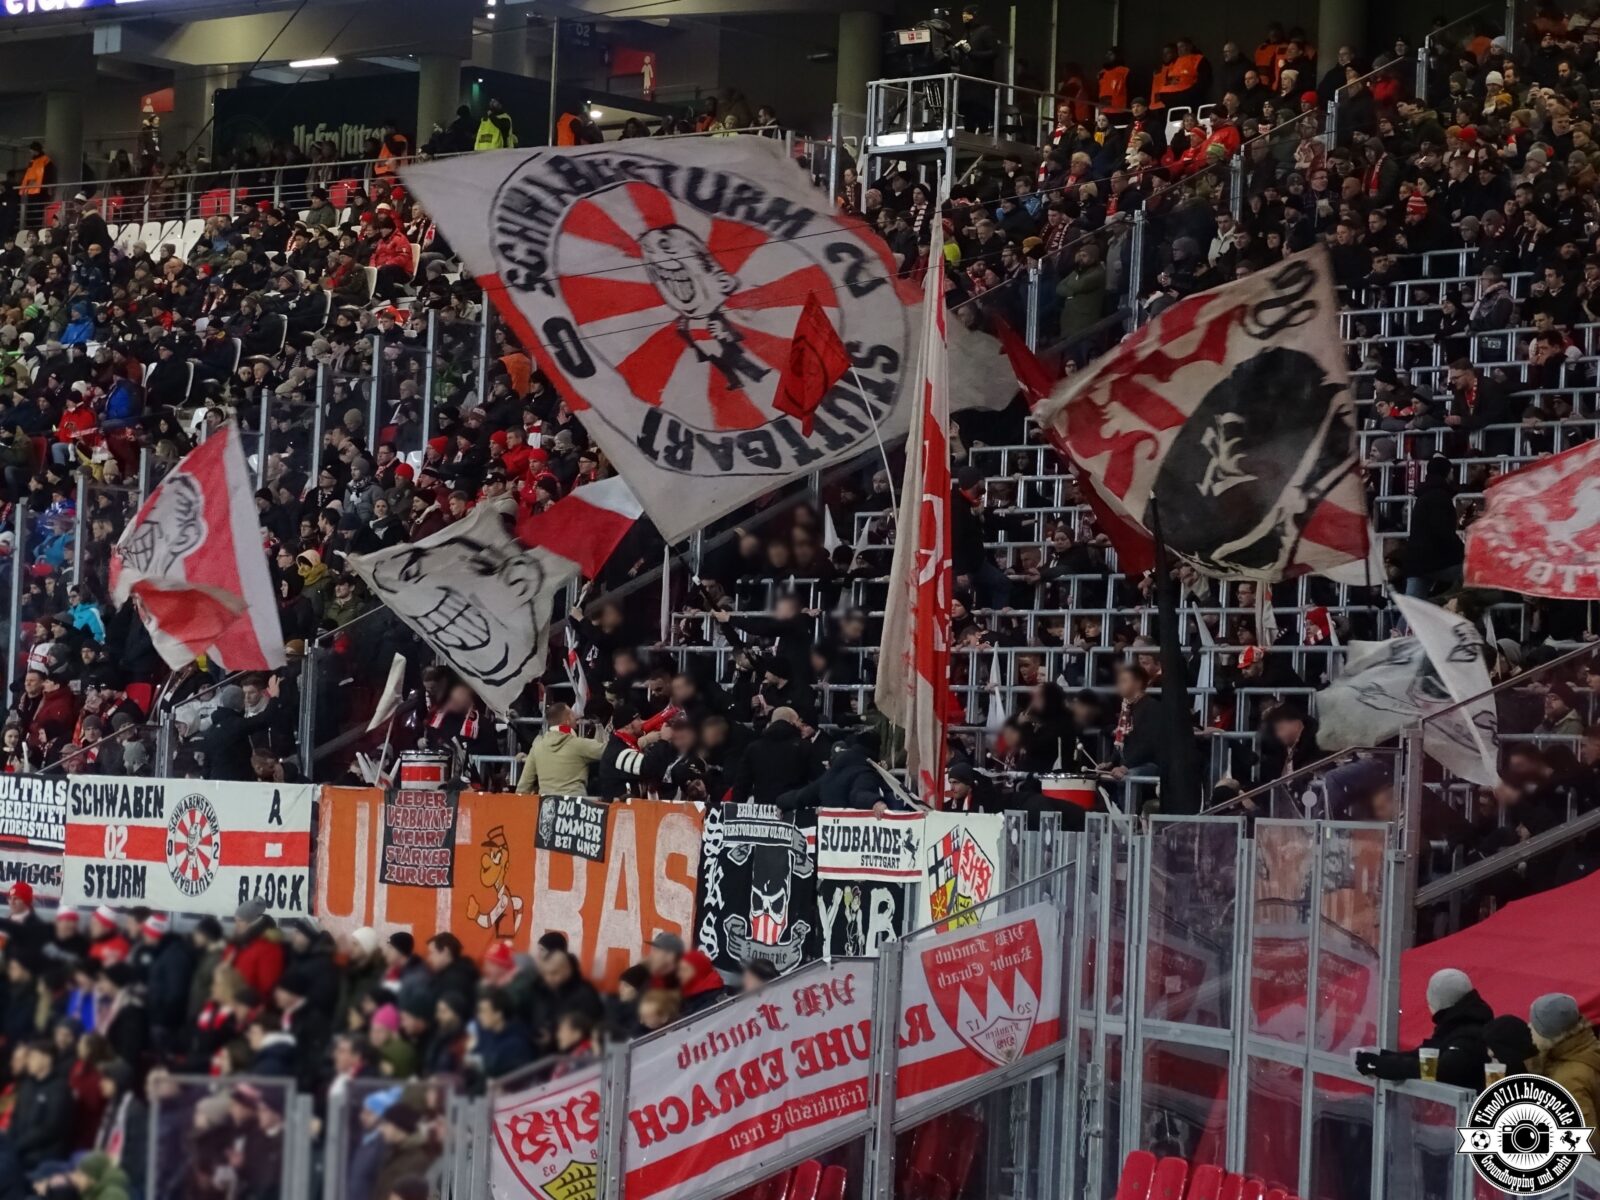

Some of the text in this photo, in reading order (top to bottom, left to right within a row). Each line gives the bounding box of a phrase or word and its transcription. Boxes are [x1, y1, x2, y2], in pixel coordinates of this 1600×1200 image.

[826, 242, 886, 298] 2
[0, 776, 66, 806] ULTRAS
[71, 783, 165, 819] SCHWABEN
[395, 790, 447, 808] JEDER
[0, 800, 65, 825] BEDEUTET
[168, 795, 220, 836] SCHWABENSTURM
[268, 789, 282, 825] A
[386, 805, 454, 829] VERBANNTE
[557, 800, 604, 824] DU BIST
[736, 803, 783, 820] EHRE ALLE
[392, 828, 447, 847] KEHRT
[555, 816, 602, 843] IMMER
[724, 823, 793, 841] VERSTORBENEN ULTRAS
[821, 818, 902, 855] SÜDBANDE
[104, 825, 128, 860] 02
[167, 839, 173, 856] 0
[213, 842, 219, 860] 2
[554, 835, 601, 858] BEI UNS!
[861, 855, 901, 869] STUTTGART
[84, 864, 147, 900] STURM
[171, 866, 214, 894] STUTTGART
[385, 864, 450, 885] ZURÜCK
